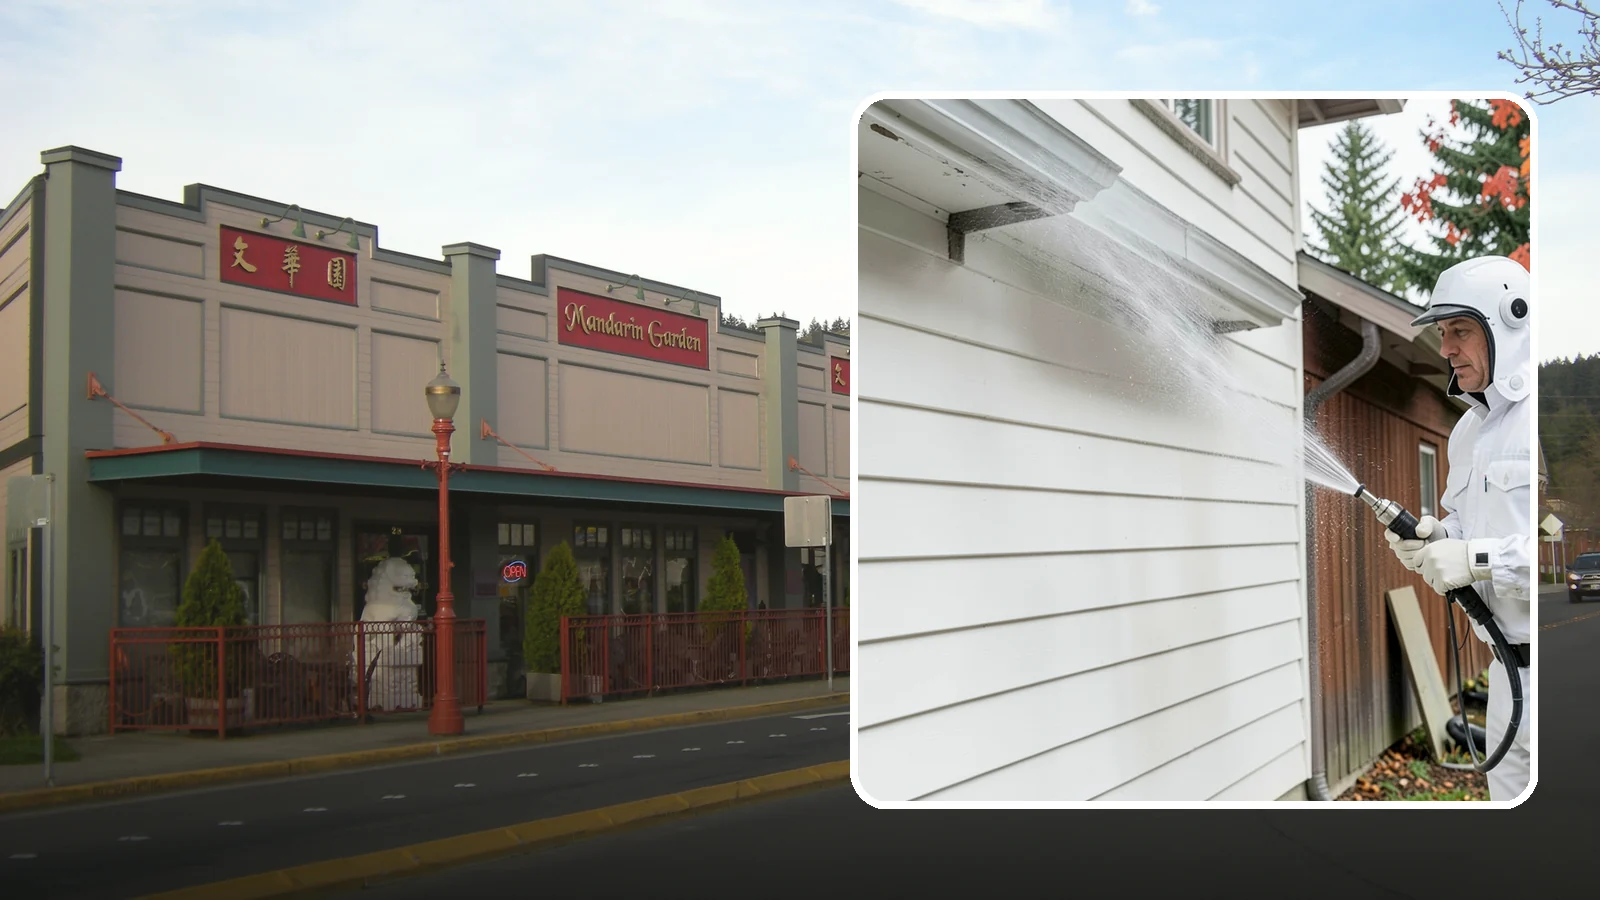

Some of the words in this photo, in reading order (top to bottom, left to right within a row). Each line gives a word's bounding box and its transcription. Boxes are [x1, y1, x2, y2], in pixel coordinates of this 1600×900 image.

[565, 302, 644, 340] Mandarin
[648, 320, 701, 352] Garden
[503, 565, 527, 578] OPEN
